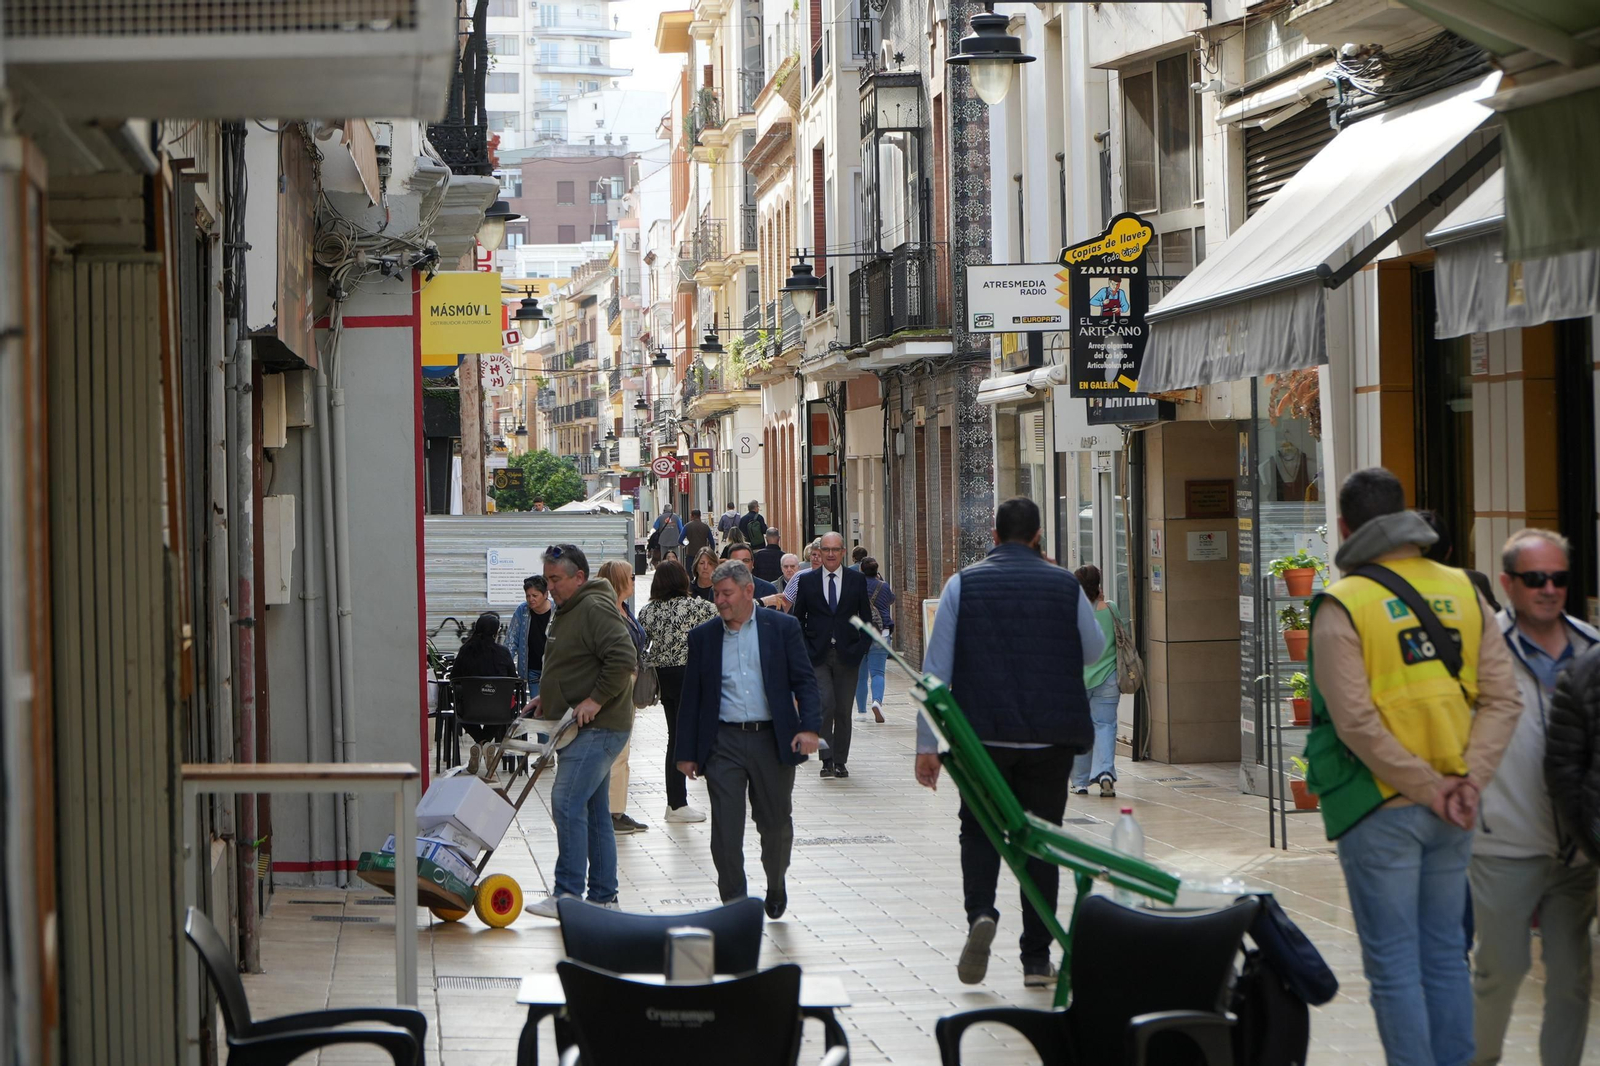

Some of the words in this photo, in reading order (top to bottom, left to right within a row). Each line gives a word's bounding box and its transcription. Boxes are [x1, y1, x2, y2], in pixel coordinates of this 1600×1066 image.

[1071, 244, 1102, 259] Copias
[1105, 239, 1116, 249] de
[1120, 229, 1147, 244] llaves
[1101, 252, 1120, 264] Todo
[1121, 243, 1140, 258] tipo!
[1080, 266, 1139, 275] ZAPATERO
[983, 280, 1046, 289] ATRESMEDIA
[1020, 288, 1047, 296] RADIO
[1080, 317, 1093, 325] EL
[1079, 325, 1142, 337] ARTESANO
[1093, 351, 1104, 359] del
[1122, 361, 1135, 370] piel
[1079, 381, 1089, 390] EN
